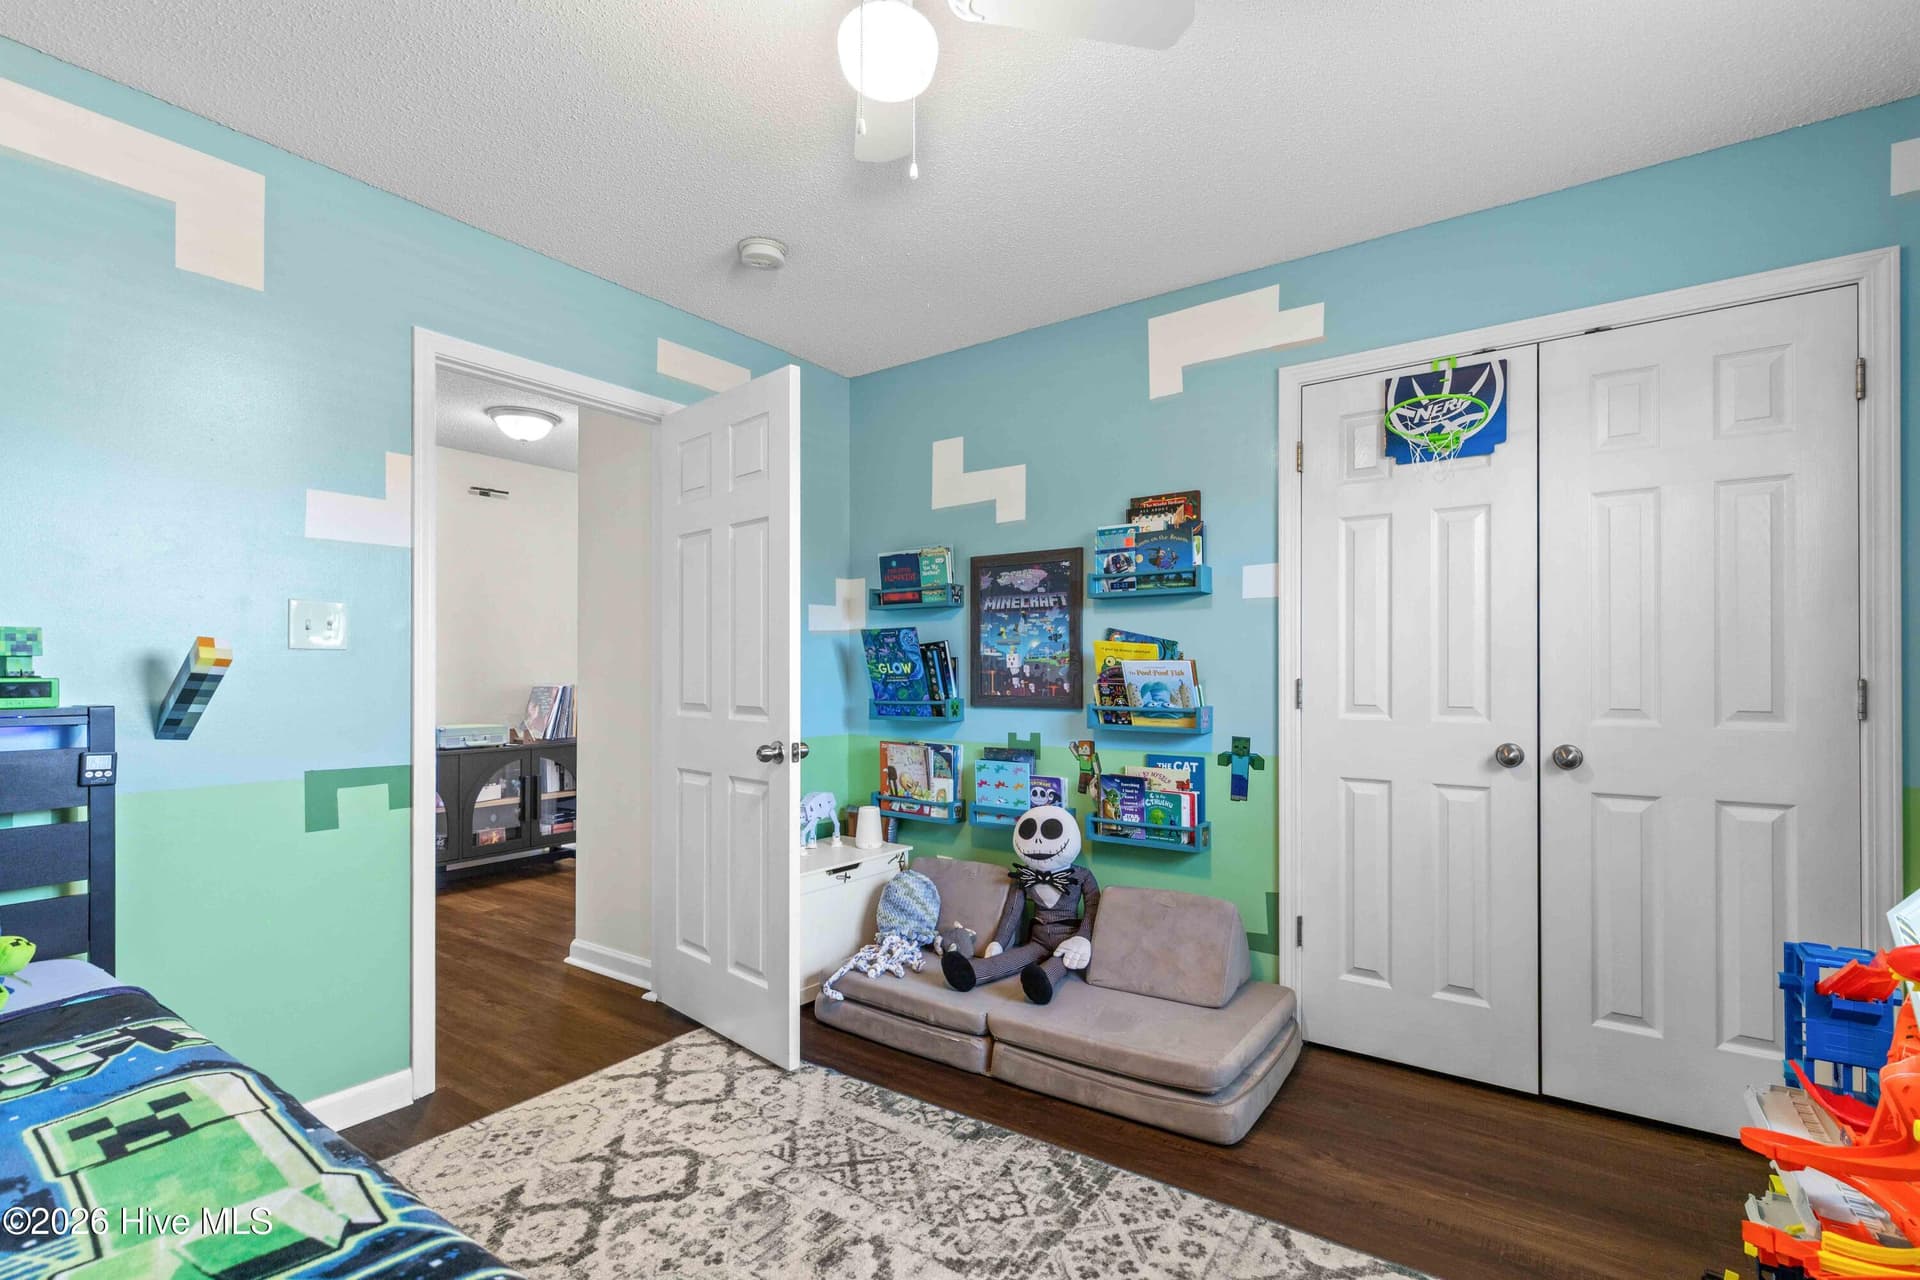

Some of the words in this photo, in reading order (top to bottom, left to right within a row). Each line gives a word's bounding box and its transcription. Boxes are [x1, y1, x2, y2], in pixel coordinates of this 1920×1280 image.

[1414, 397, 1467, 423] NERF
[983, 593, 1068, 611] MINECRAFT
[878, 662, 912, 674] GLOW
[1156, 762, 1172, 770] THE
[1173, 761, 1199, 773] CAT
[1151, 771, 1172, 784] MYSELF
[1145, 798, 1174, 809] CTHULHU
